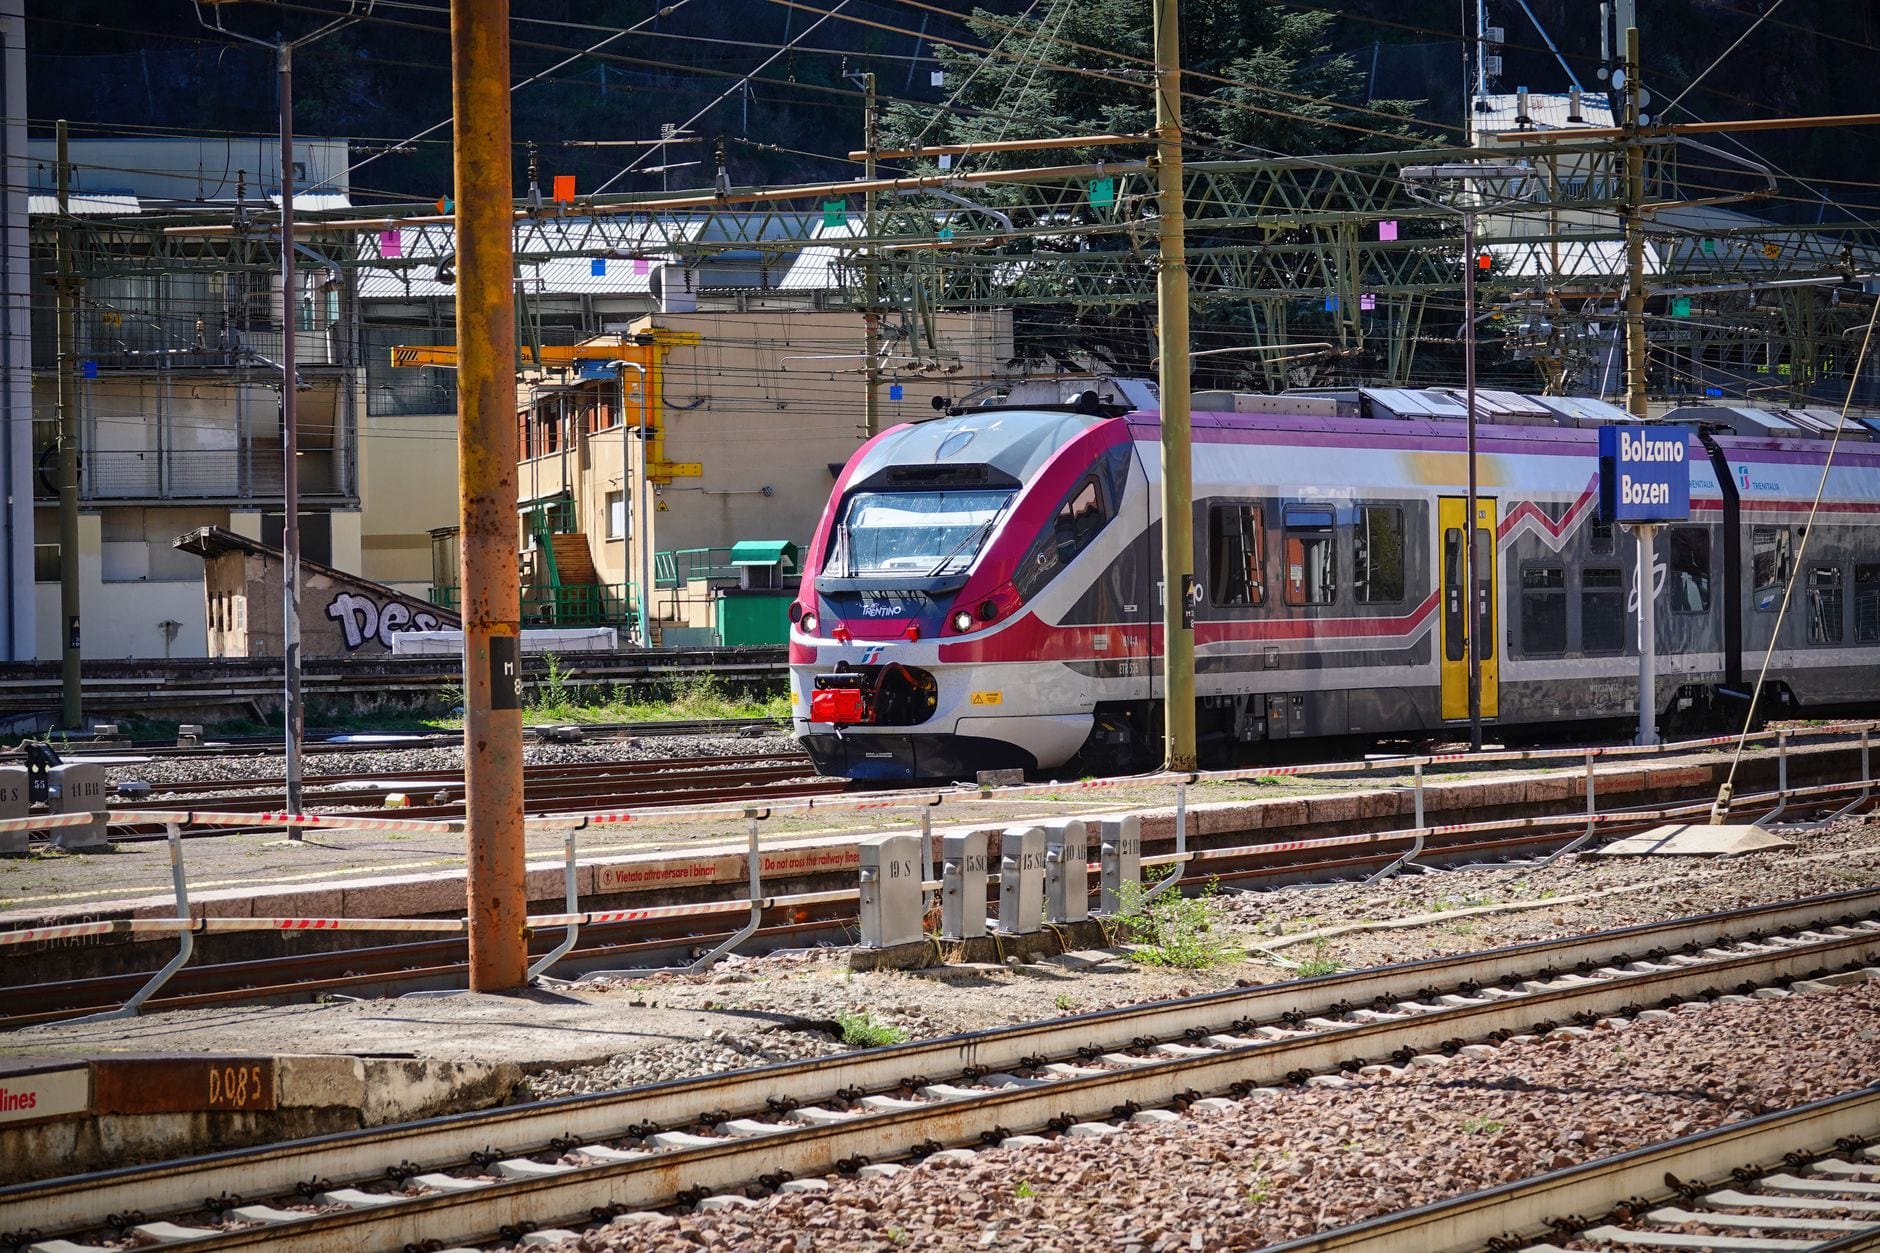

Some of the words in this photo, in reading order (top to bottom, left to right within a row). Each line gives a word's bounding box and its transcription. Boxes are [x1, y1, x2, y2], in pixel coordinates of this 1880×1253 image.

[1092, 182, 1097, 192] 2
[1621, 430, 1683, 462] Bolzano
[1622, 474, 1669, 504] Bozen
[1752, 481, 1780, 490] TRENITALIA
[863, 604, 902, 617] TRENTINO
[11, 787, 18, 801] S
[765, 858, 775, 871] Do
[776, 858, 787, 870] not
[789, 857, 805, 868] cross
[806, 854, 817, 867] the
[818, 851, 844, 866] railway
[845, 850, 860, 863] lines
[904, 860, 911, 877] S
[615, 870, 642, 883] Vietato
[644, 867, 688, 881] attraversare
[693, 863, 716, 877] binari
[0, 1087, 37, 1113] lines
